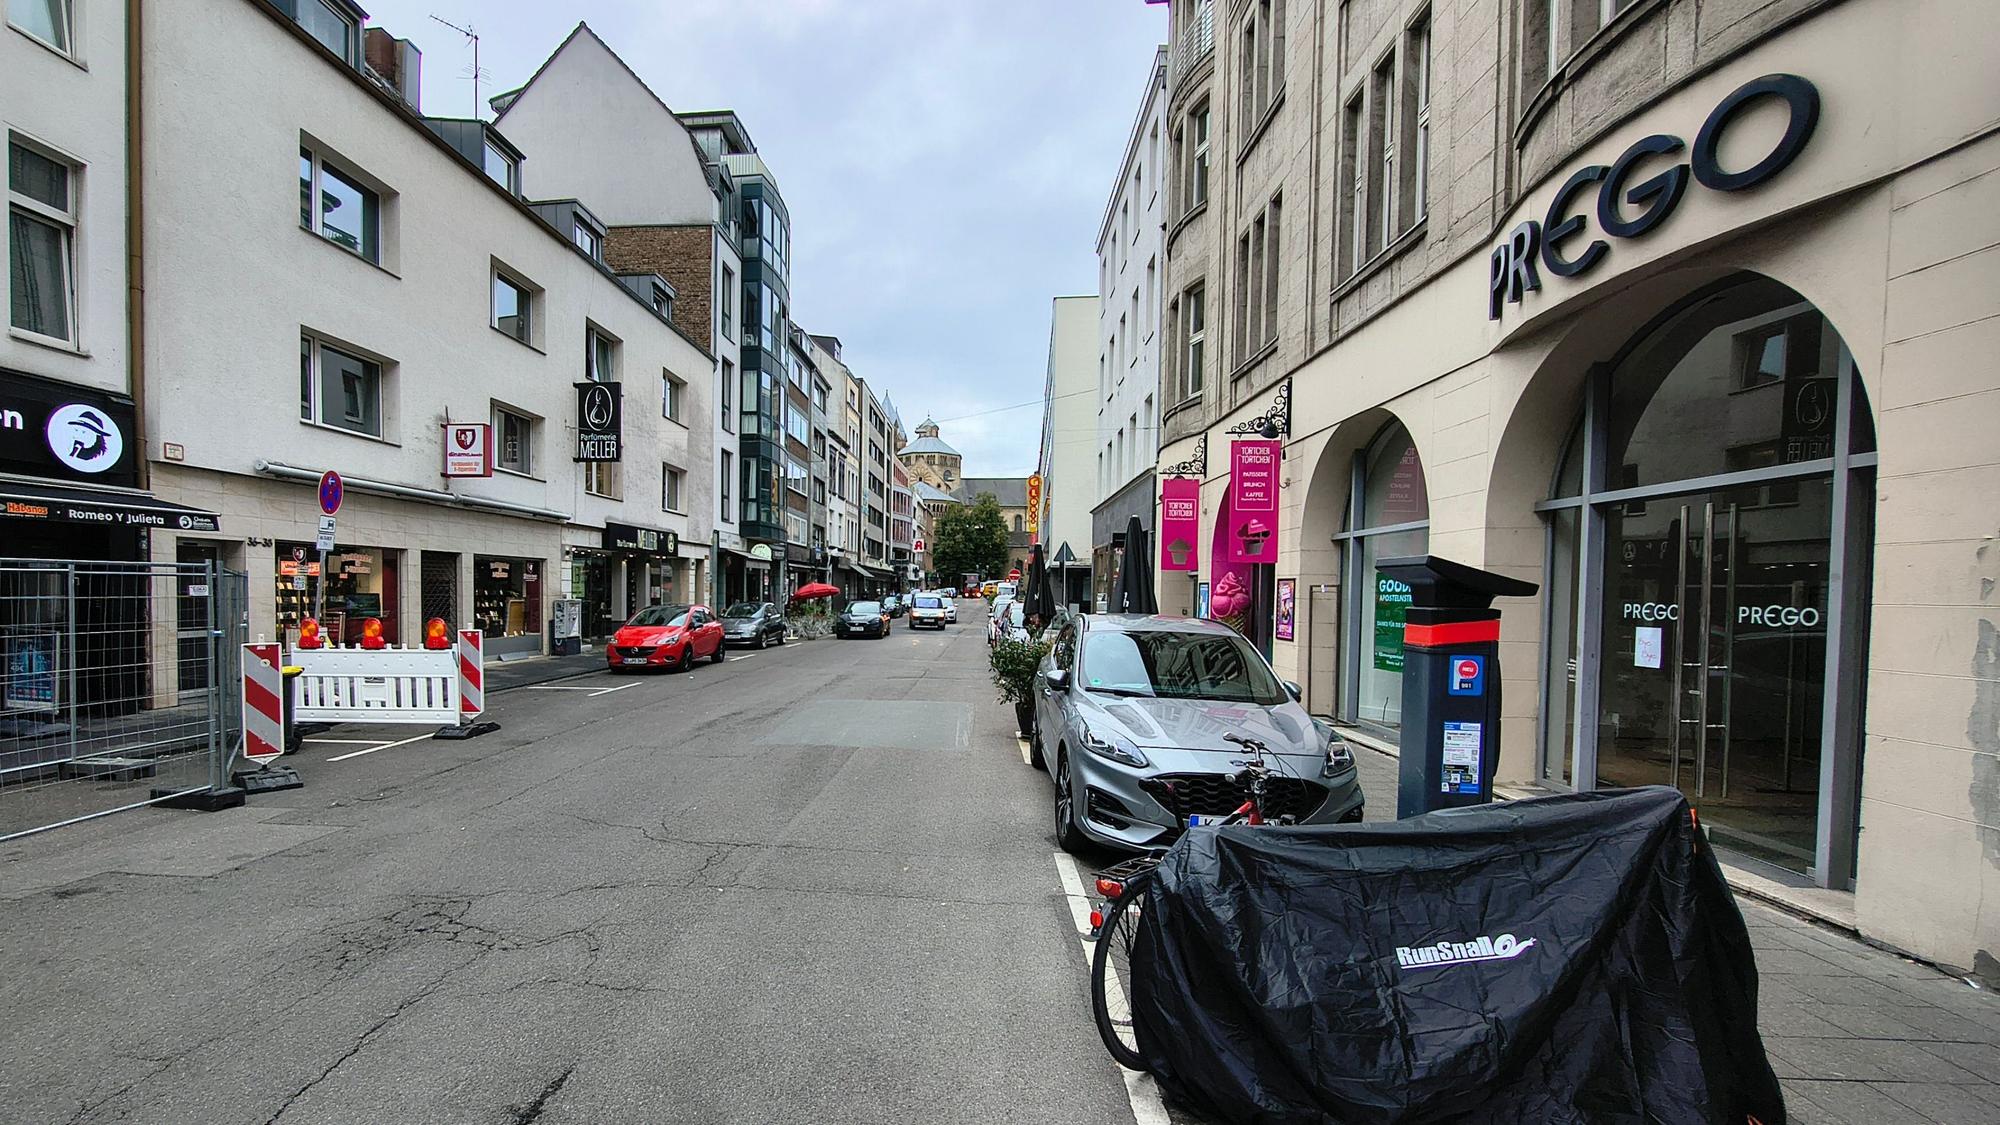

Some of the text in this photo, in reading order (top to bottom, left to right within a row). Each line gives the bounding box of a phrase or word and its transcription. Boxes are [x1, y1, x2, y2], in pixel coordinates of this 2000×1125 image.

[1489, 73, 1821, 320] PREGO
[580, 441, 617, 459] MELLER
[6, 501, 49, 515] Habanos
[68, 509, 165, 525] Romeo Y Julieta
[1738, 604, 1819, 627] PREGO
